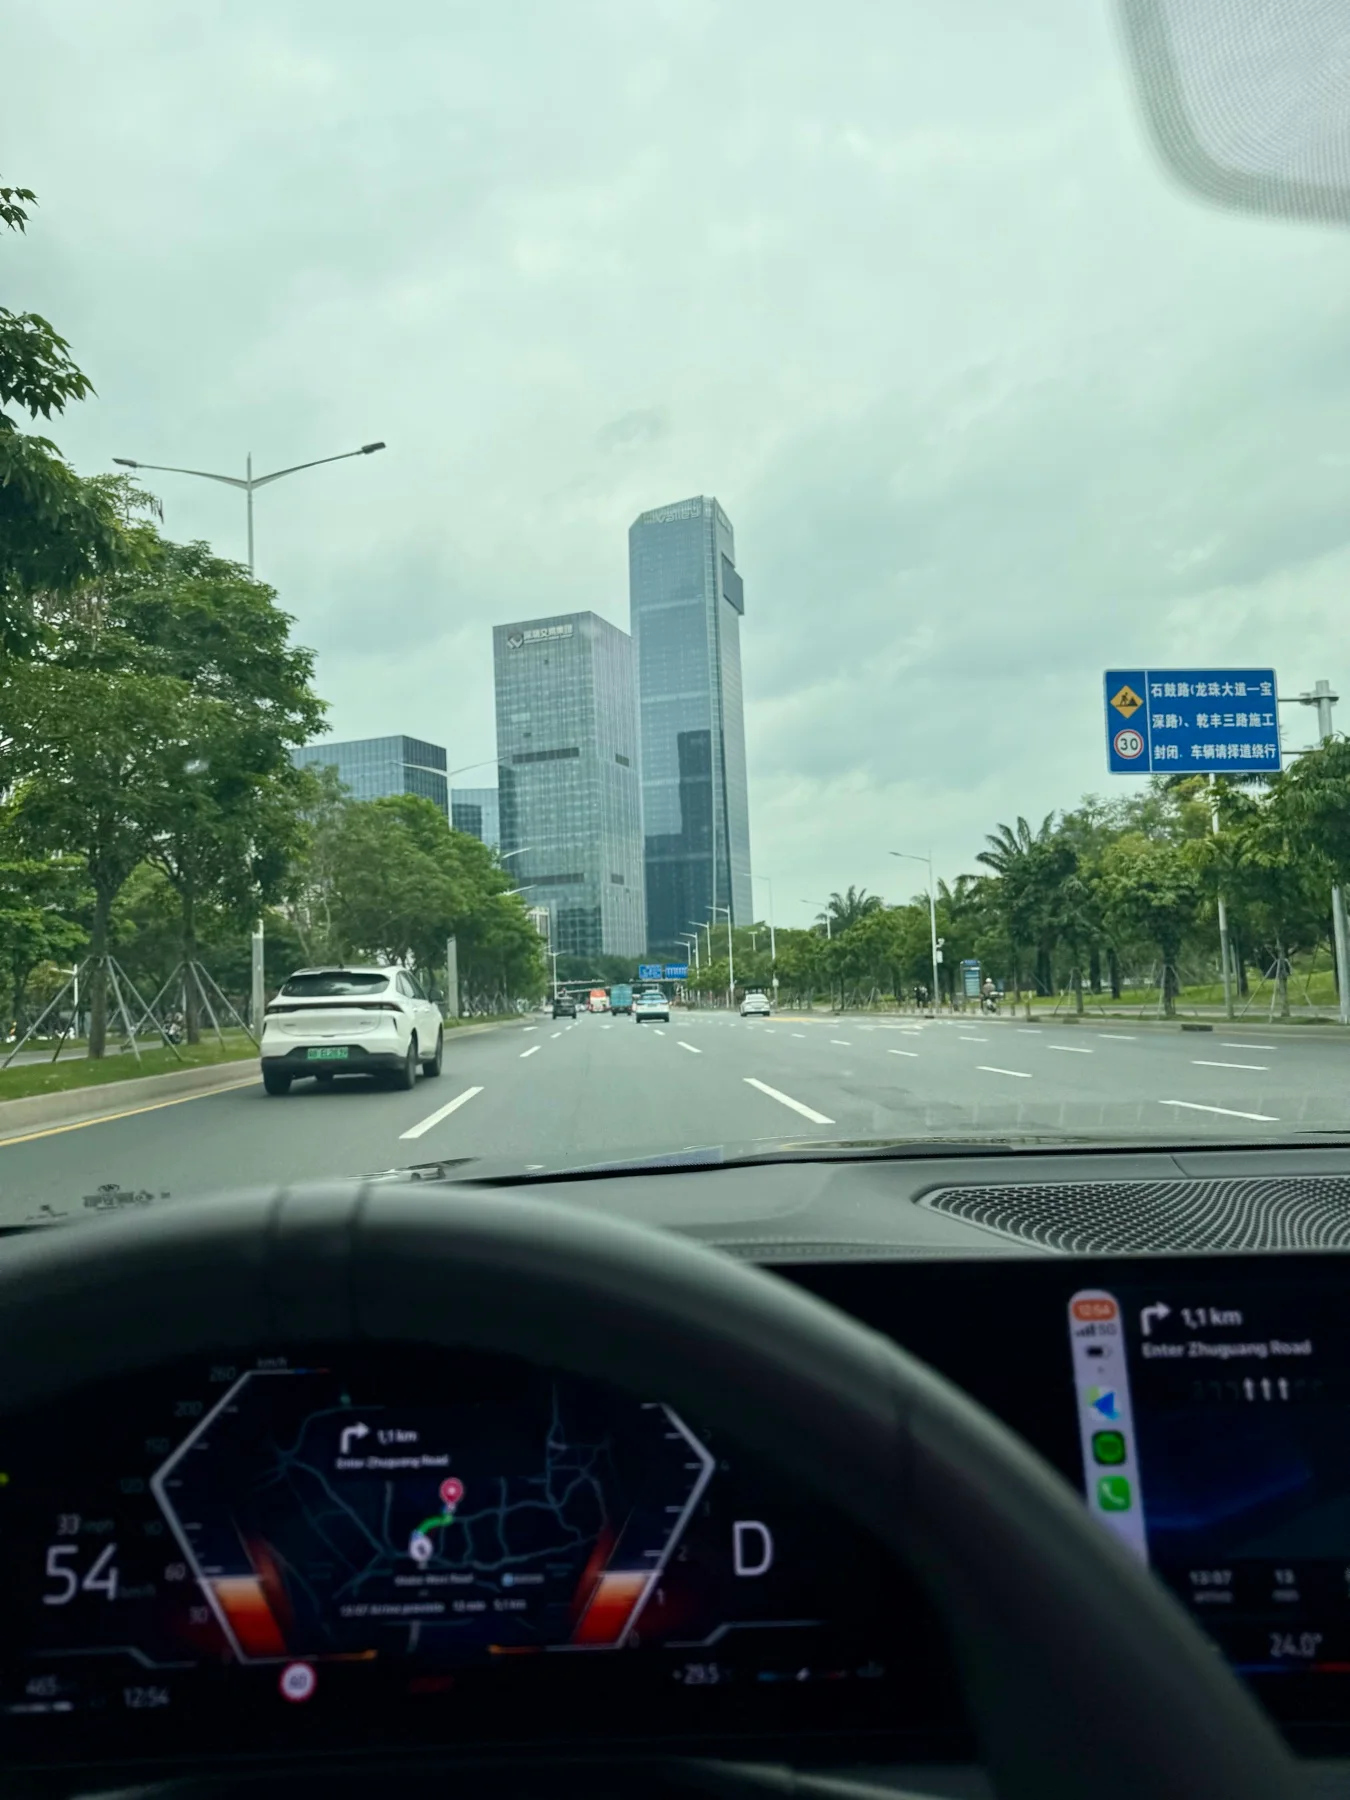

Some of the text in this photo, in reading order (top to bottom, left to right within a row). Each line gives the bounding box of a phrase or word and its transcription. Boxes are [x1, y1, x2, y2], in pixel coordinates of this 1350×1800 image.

[1119, 738, 1139, 751] 30
[1210, 1306, 1244, 1327] km
[1141, 1339, 1313, 1361] Enter Zhuguang Road
[398, 1429, 419, 1443] km
[335, 1457, 365, 1470] Enter
[421, 1454, 451, 1467] Road
[733, 1520, 775, 1577] D
[42, 1542, 119, 1606] 54
